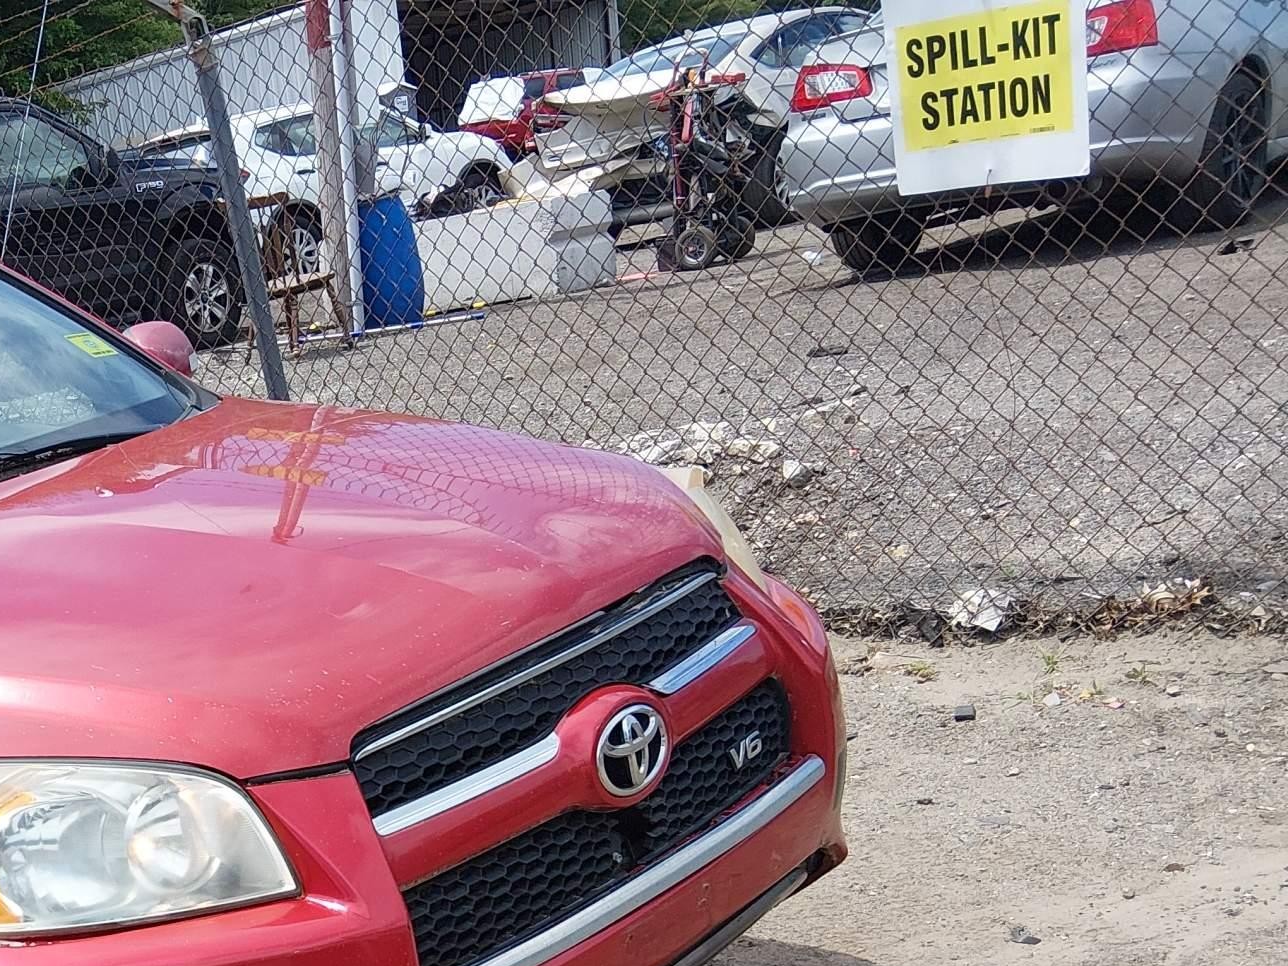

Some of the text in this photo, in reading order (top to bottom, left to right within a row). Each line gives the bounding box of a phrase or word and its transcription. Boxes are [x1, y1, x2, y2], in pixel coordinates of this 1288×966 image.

[906, 13, 1061, 78] SPILL-KIT
[921, 74, 1051, 131] STATION
[729, 730, 762, 769] V6
